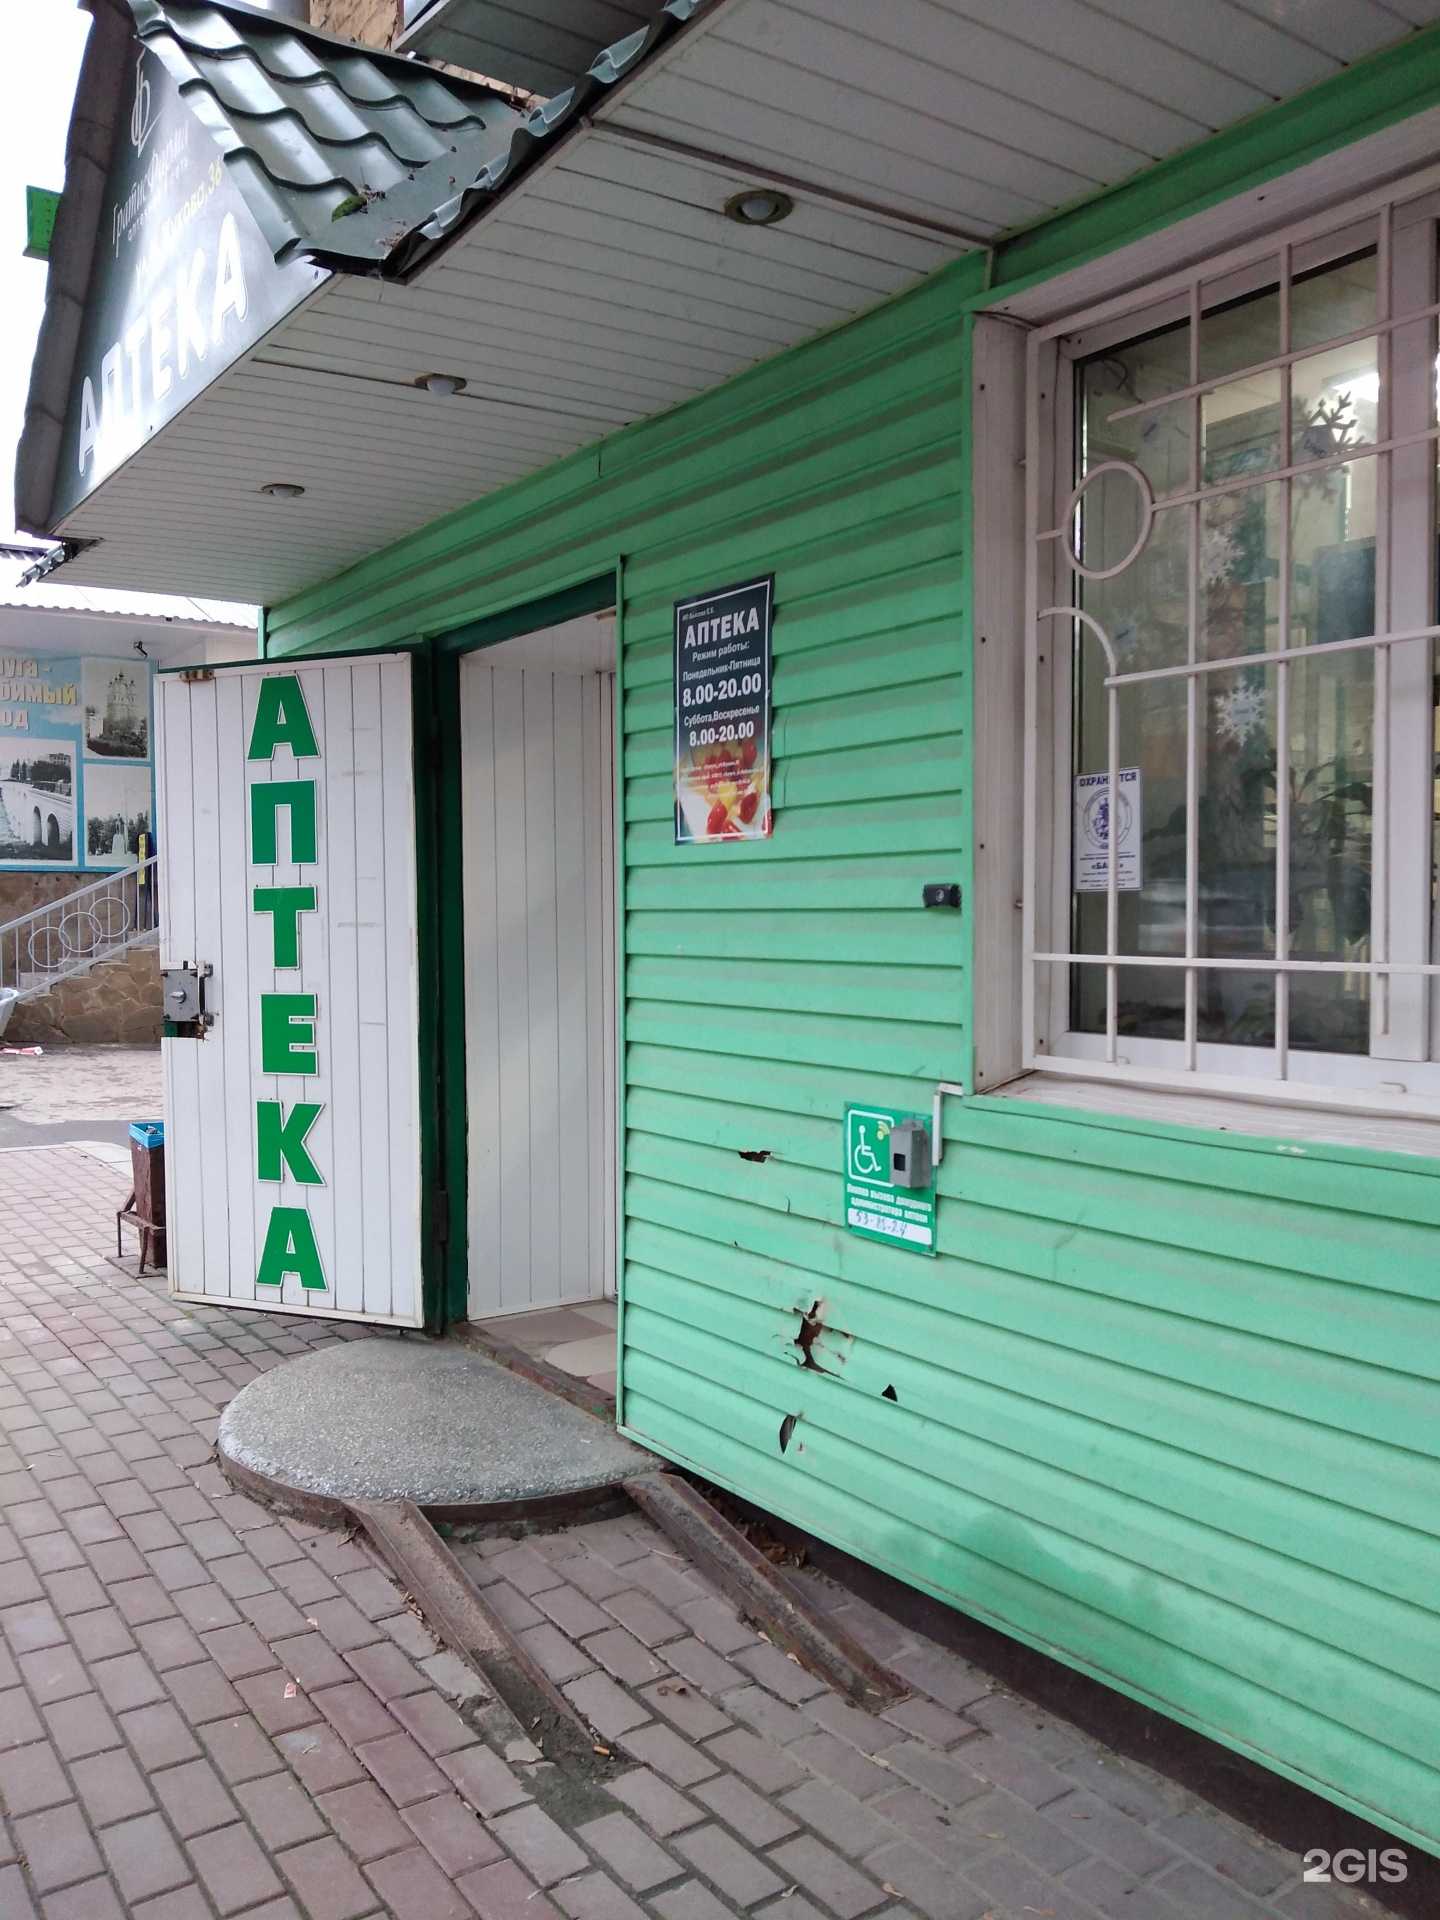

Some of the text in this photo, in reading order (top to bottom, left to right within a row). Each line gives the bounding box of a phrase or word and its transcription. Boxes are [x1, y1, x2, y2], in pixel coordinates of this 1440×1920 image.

[78, 212, 248, 477] АПТЕКА
[684, 607, 760, 650] АПТЕКА
[692, 640, 751, 662] Режим работы:
[683, 656, 761, 681] Понедельник-Пятница
[683, 673, 762, 707] 8.00-20.00
[689, 720, 754, 747] 8.00-20.00
[1080, 772, 1137, 787] ОХРАНТСЯ
[246, 672, 329, 1293] АПТЕКА
